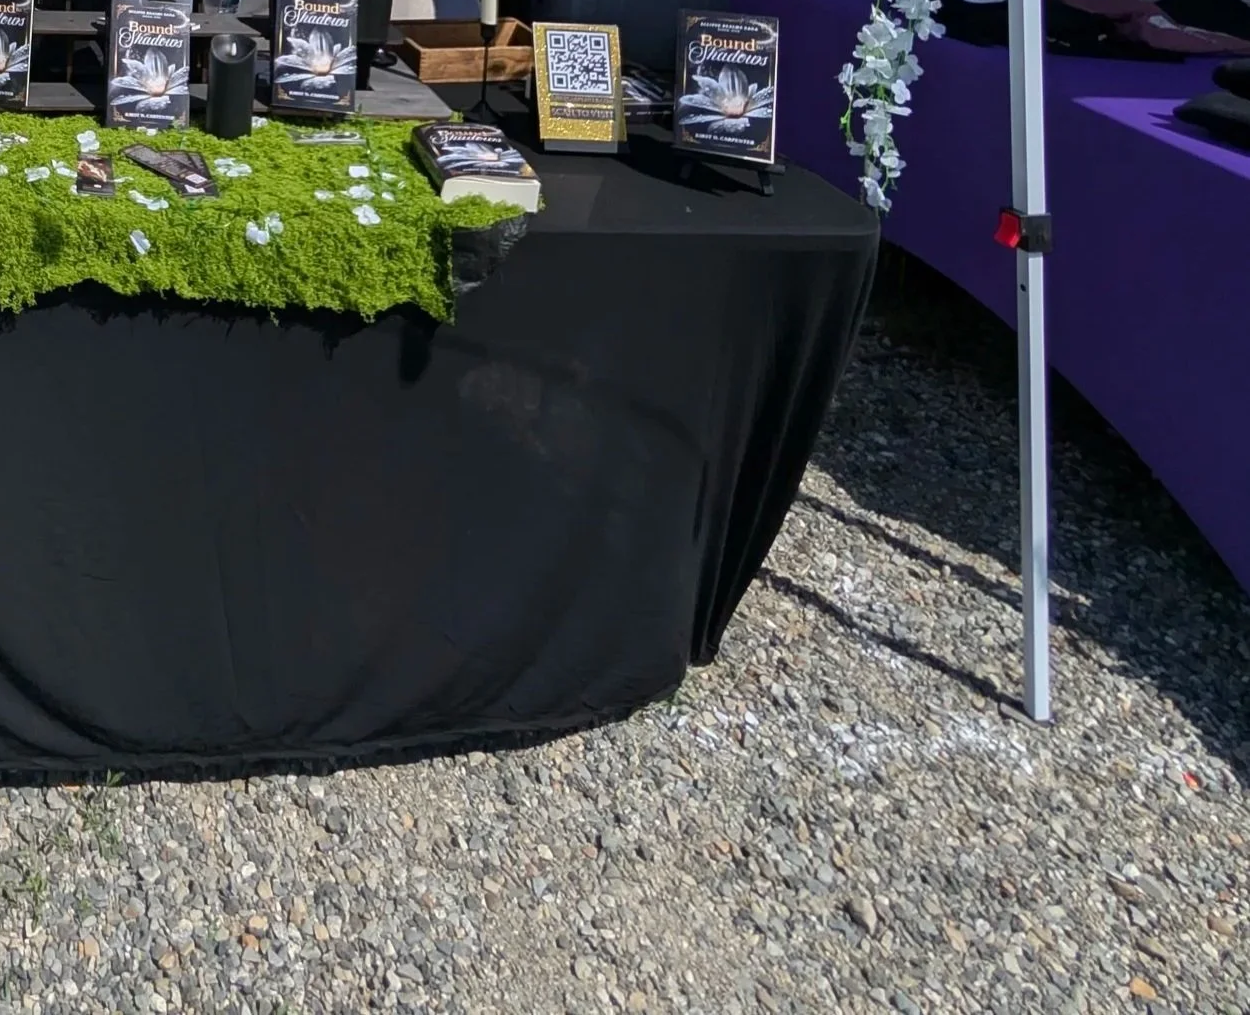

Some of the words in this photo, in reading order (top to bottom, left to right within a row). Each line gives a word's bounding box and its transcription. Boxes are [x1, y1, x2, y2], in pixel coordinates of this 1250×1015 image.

[128, 20, 174, 35] Bound
[283, 5, 350, 28] Shadows
[118, 26, 184, 48] Shadows
[700, 34, 756, 52] Bound
[688, 40, 769, 67] Shadows
